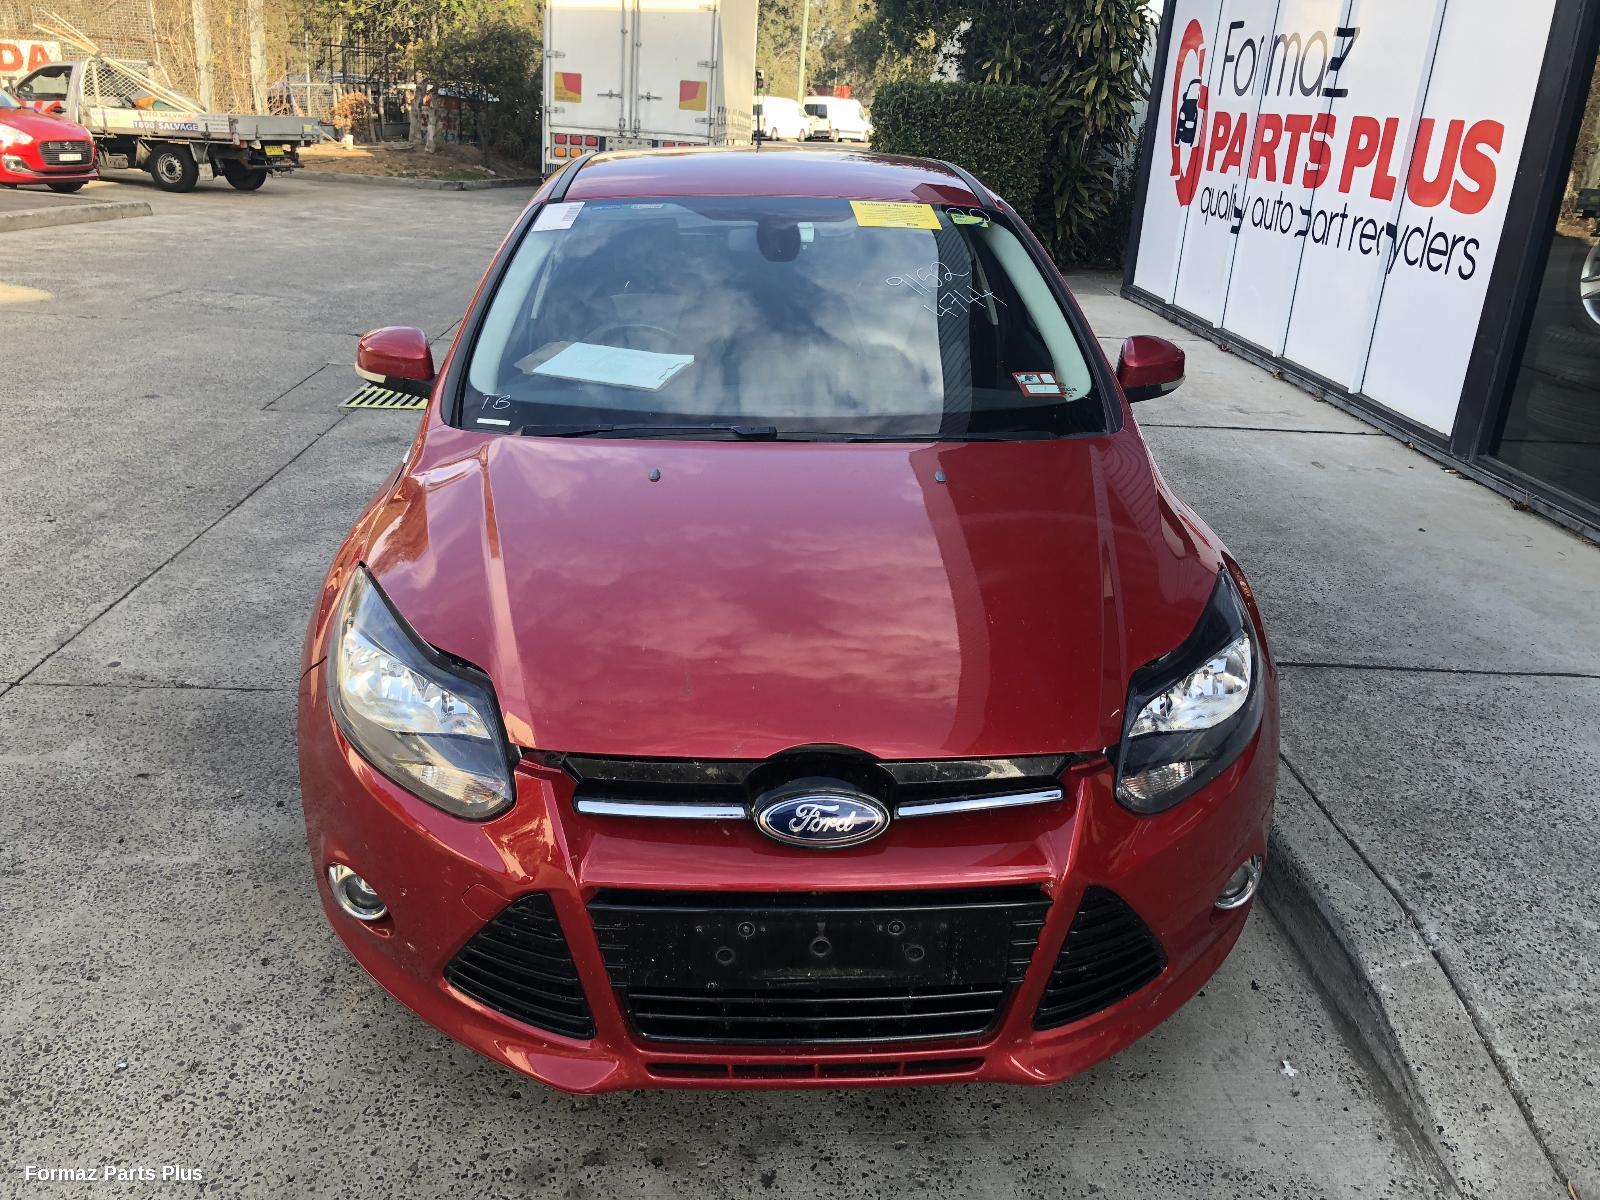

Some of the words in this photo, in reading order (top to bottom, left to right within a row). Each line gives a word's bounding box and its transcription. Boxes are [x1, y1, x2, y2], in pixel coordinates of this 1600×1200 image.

[1218, 20, 1361, 98] Formaz
[158, 122, 199, 131] SALVAGE
[1206, 111, 1337, 189] PARTS
[1338, 115, 1505, 215] PLUS
[1200, 184, 1251, 234] qualiy
[1252, 191, 1294, 234] auto
[1348, 216, 1480, 281] recyclers
[788, 803, 857, 832] Ford
